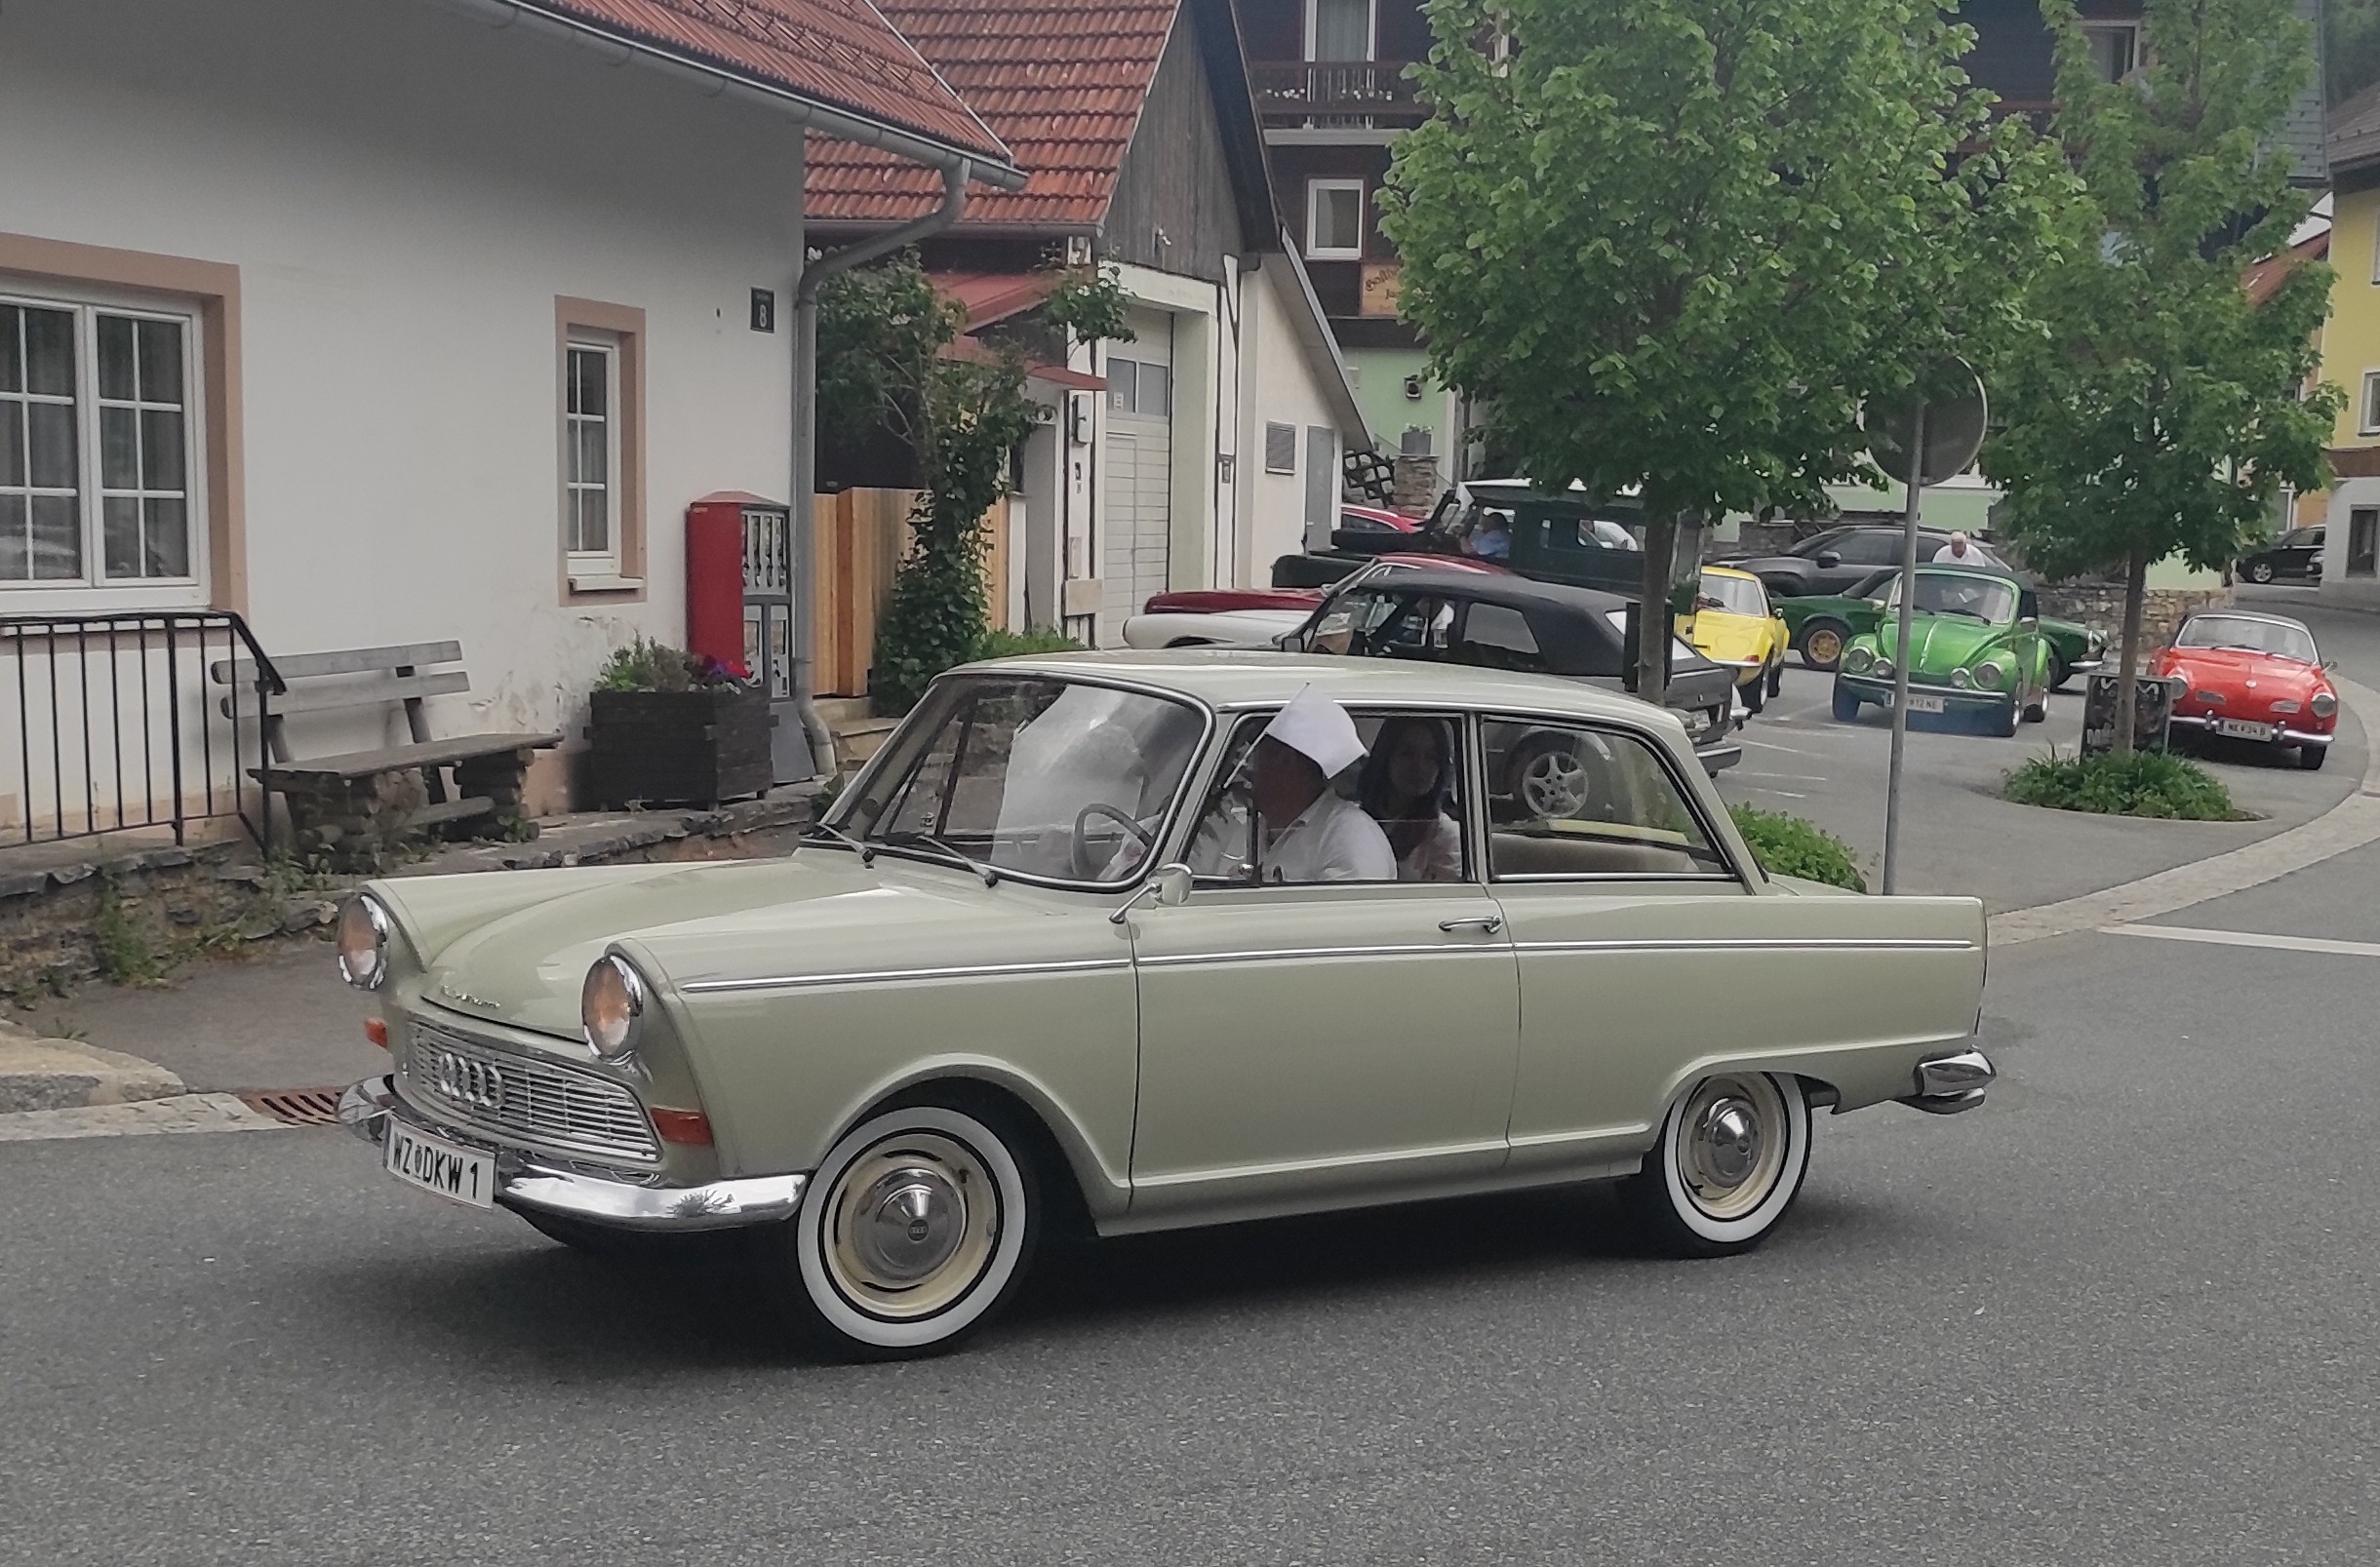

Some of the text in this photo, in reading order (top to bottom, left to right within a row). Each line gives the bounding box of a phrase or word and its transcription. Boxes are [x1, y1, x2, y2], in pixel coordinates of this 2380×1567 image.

[759, 304, 768, 328] 8
[422, 1146, 463, 1194] DKW
[469, 1161, 479, 1199] 1
